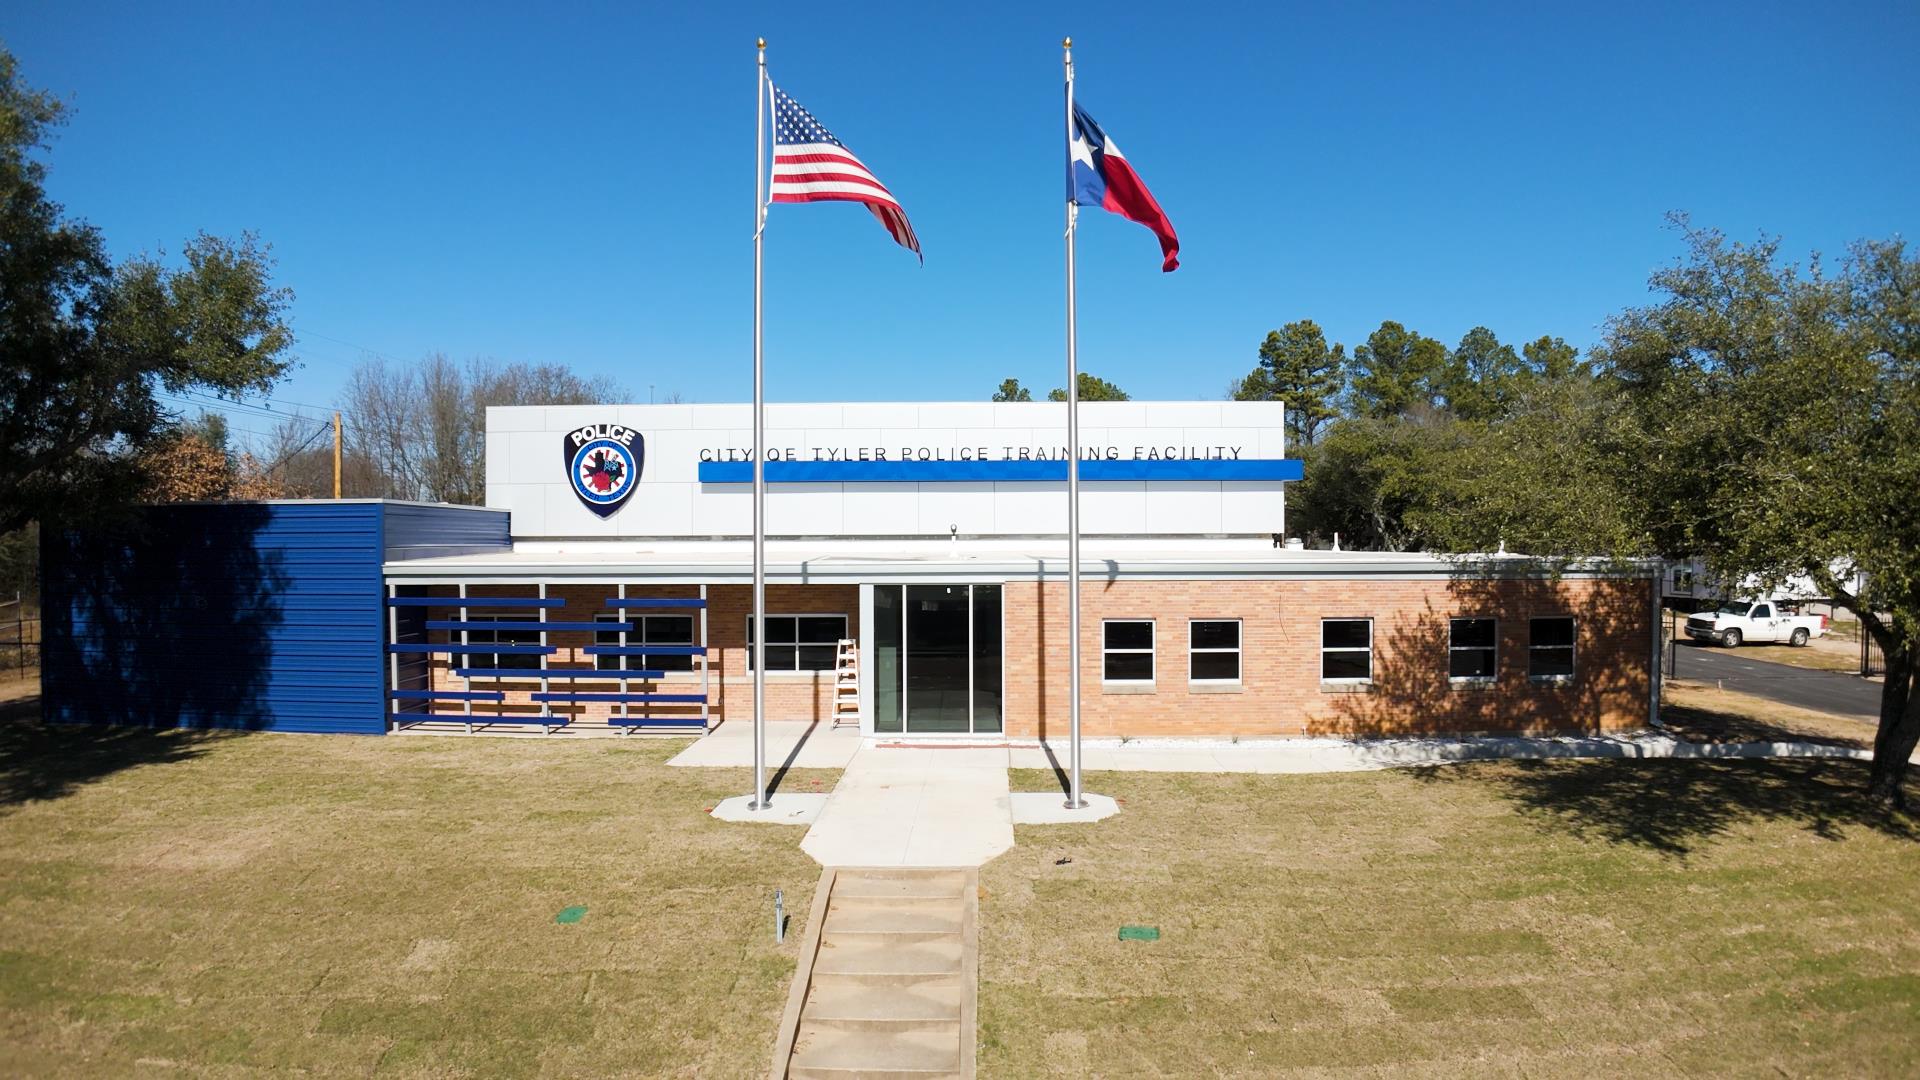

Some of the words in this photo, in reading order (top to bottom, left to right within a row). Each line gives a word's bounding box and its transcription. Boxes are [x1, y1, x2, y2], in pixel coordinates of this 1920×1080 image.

[571, 424, 635, 447] POLICE
[587, 441, 604, 451] CITY
[700, 448, 752, 462] CITY
[767, 448, 795, 461] OF
[812, 447, 886, 461] TYLER
[902, 446, 988, 461] POLICE
[1003, 446, 1119, 461] TRAINING
[1134, 446, 1242, 460] FACILITY
